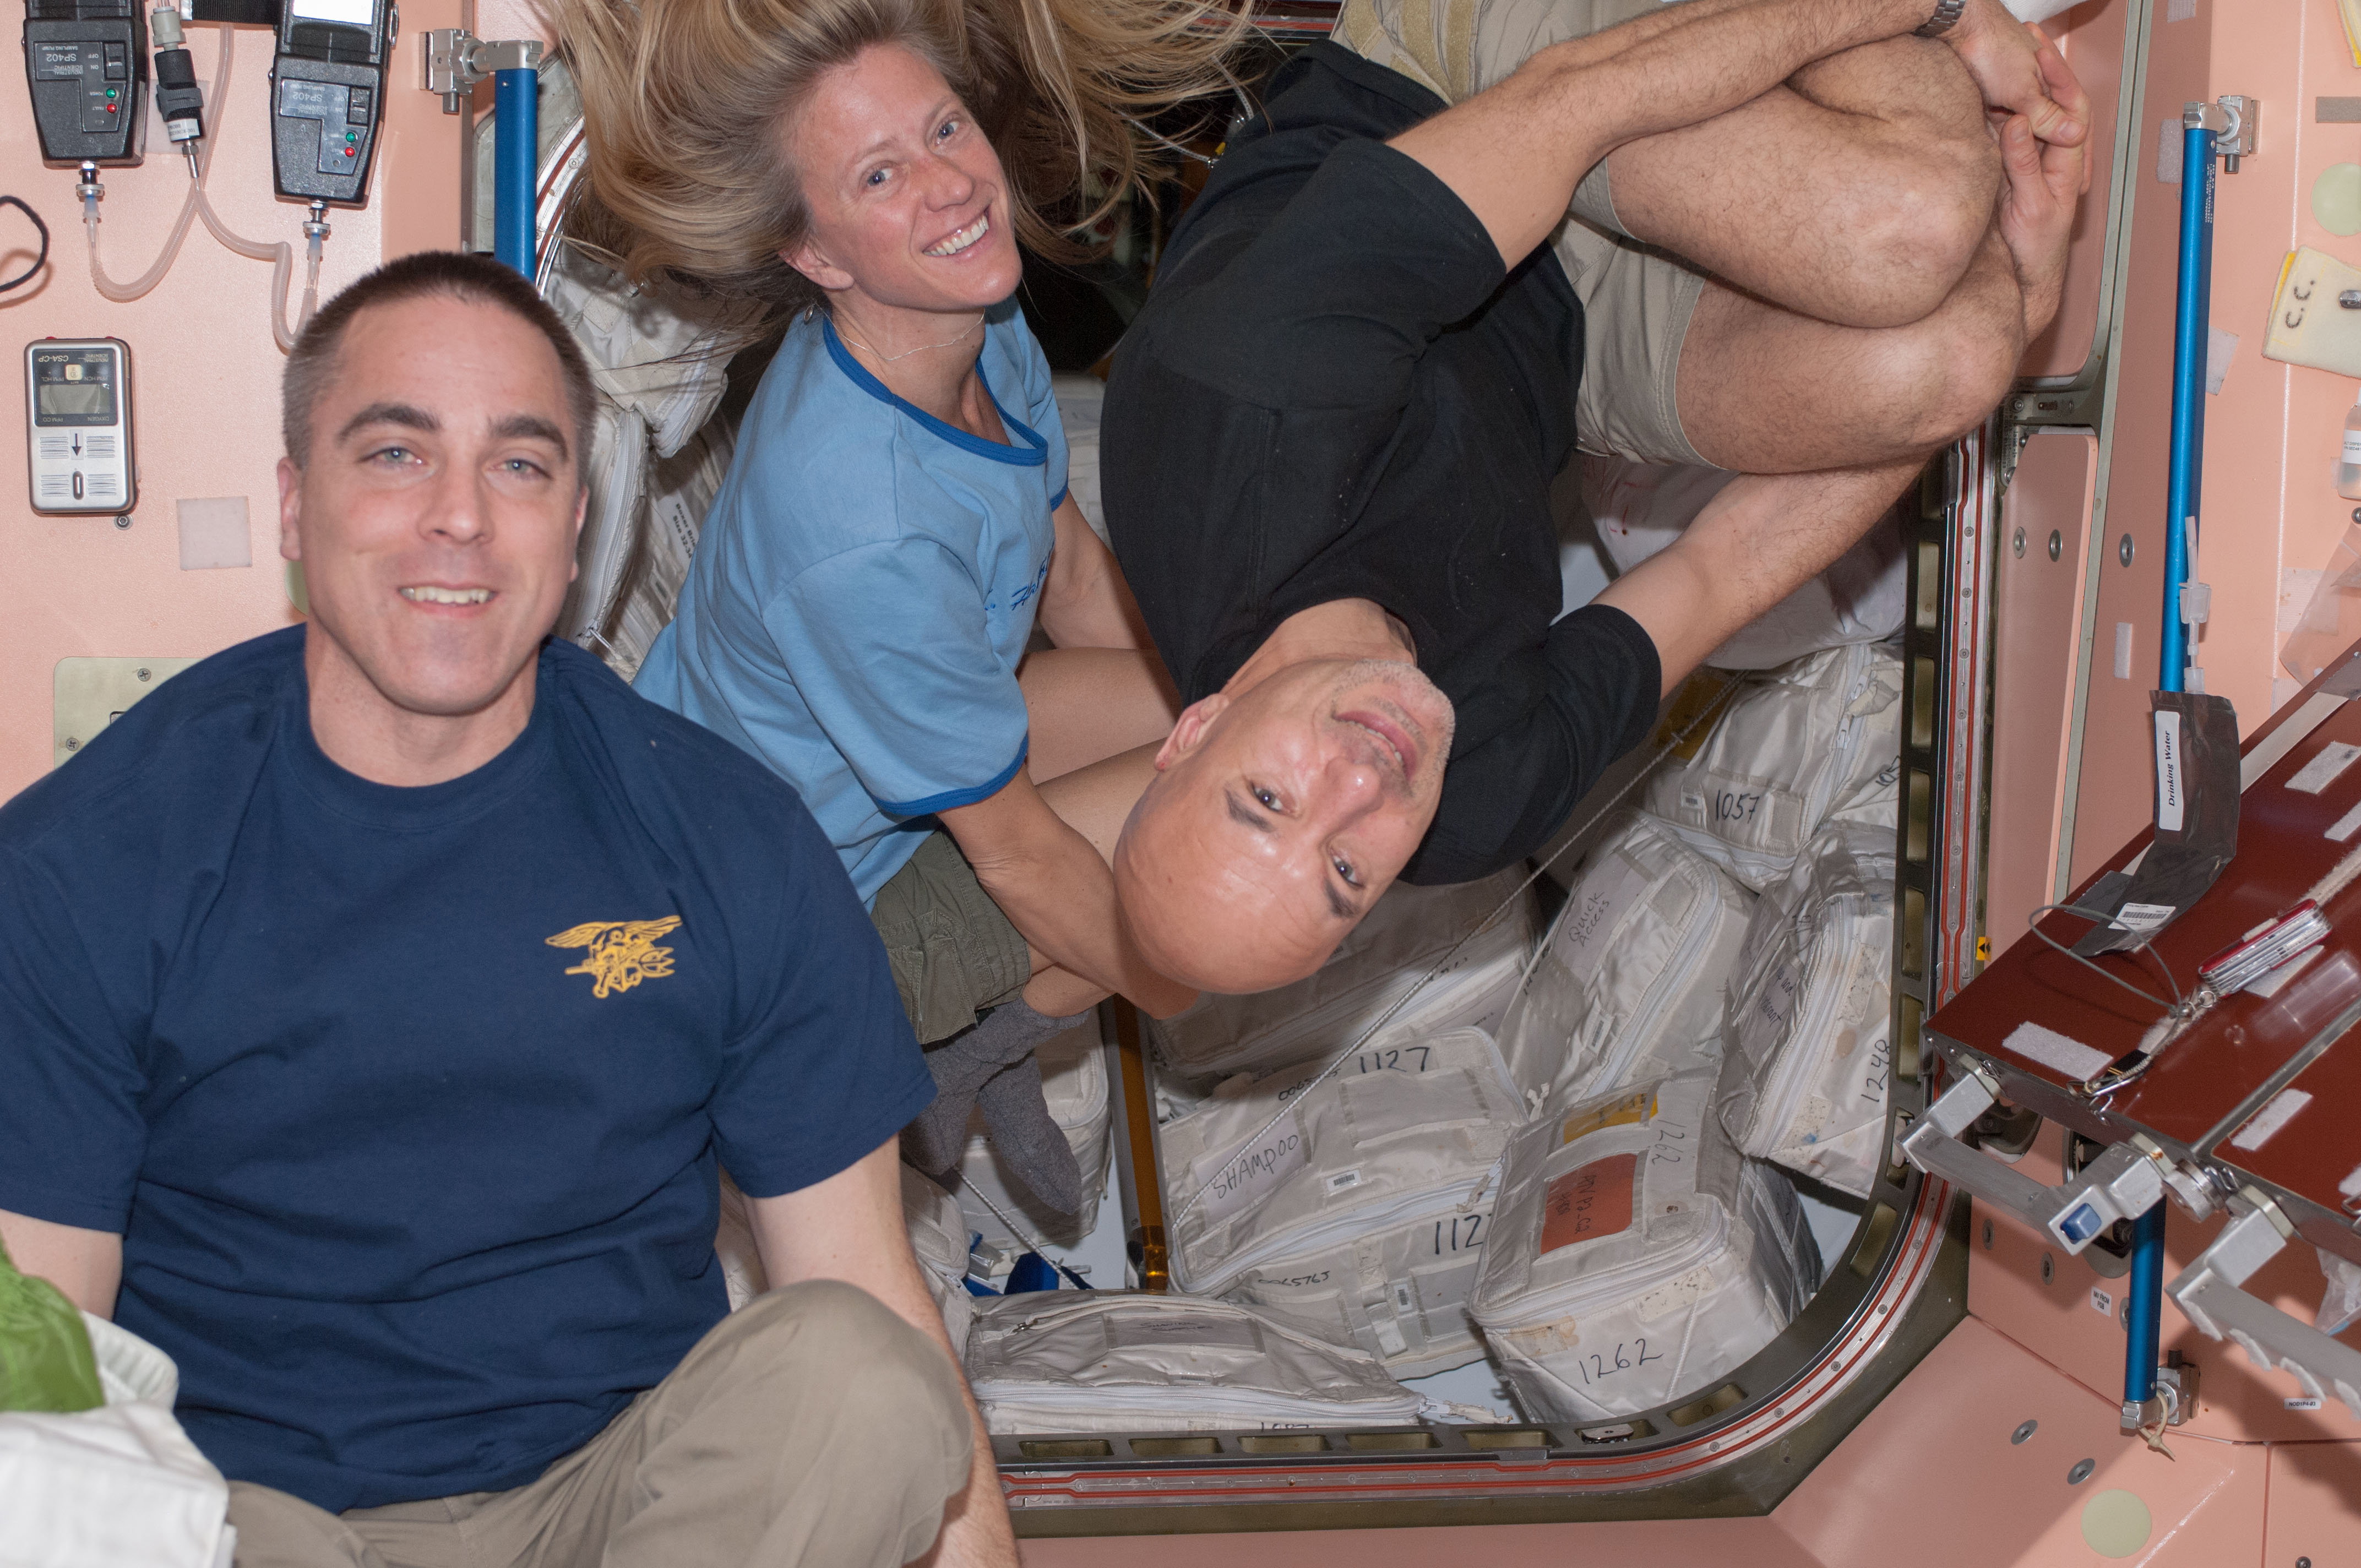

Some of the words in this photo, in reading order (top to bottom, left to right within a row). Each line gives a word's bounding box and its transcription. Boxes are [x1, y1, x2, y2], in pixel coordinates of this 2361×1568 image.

[46, 53, 77, 62] SP402
[293, 92, 323, 102] SP402
[673, 515, 683, 533] Size
[676, 503, 689, 528] Boxer
[2167, 764, 2175, 807] Drinking
[1715, 790, 1761, 823] 1057
[1568, 890, 1604, 943] Quick
[1579, 897, 1609, 947] Access
[1360, 1047, 1430, 1074] 1127
[1862, 1038, 1891, 1103] 1248
[1650, 1119, 1685, 1166] 1262
[1213, 1134, 1298, 1199] SHAMPOO
[2099, 1292, 2109, 1304] FROM
[1578, 1338, 1663, 1384] 1262
